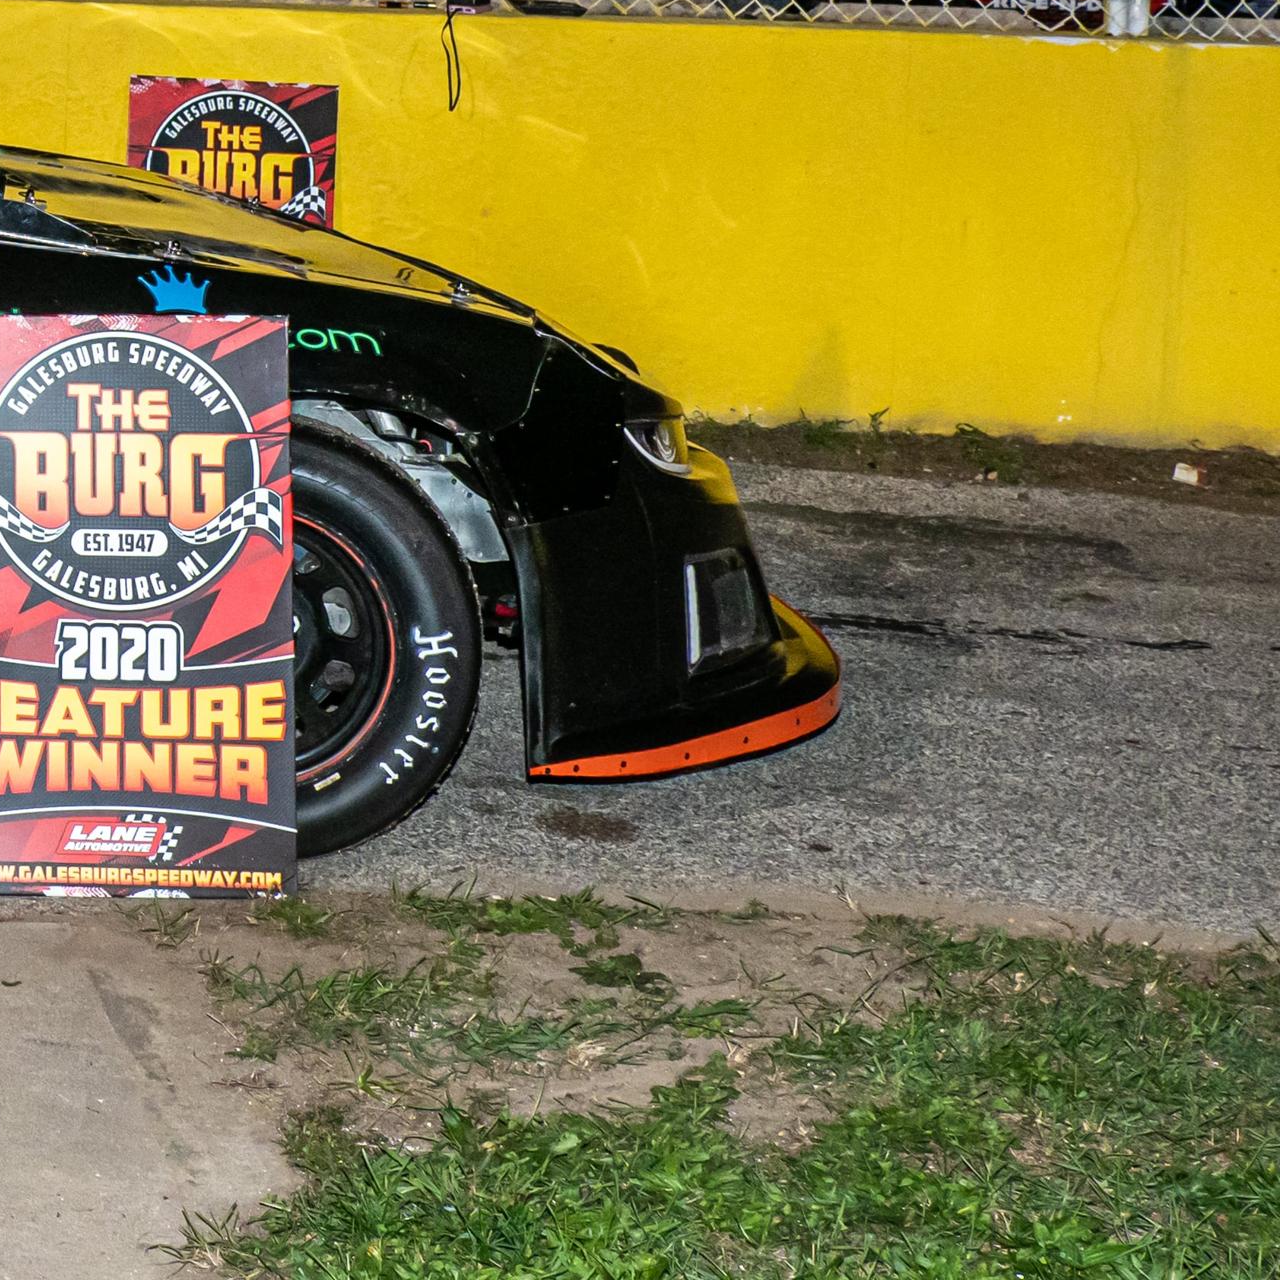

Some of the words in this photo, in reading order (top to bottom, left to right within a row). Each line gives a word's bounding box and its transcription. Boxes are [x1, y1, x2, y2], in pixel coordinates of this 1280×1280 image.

[165, 96, 234, 140] GALESBURG
[238, 97, 299, 144] SPEEDWAY
[201, 121, 263, 151] THE
[8, 342, 120, 416] GALESBURG
[128, 342, 232, 416] SPEEDWAY
[67, 382, 172, 432] THE
[1, 431, 240, 532] BURG
[83, 533, 114, 553] EST.
[118, 533, 155, 553] 1947
[177, 549, 209, 581] MI
[60, 623, 179, 683] 2020
[380, 625, 458, 785] Hoosier
[64, 841, 154, 853] AUTOMOTIVE
[69, 824, 158, 843] LANE
